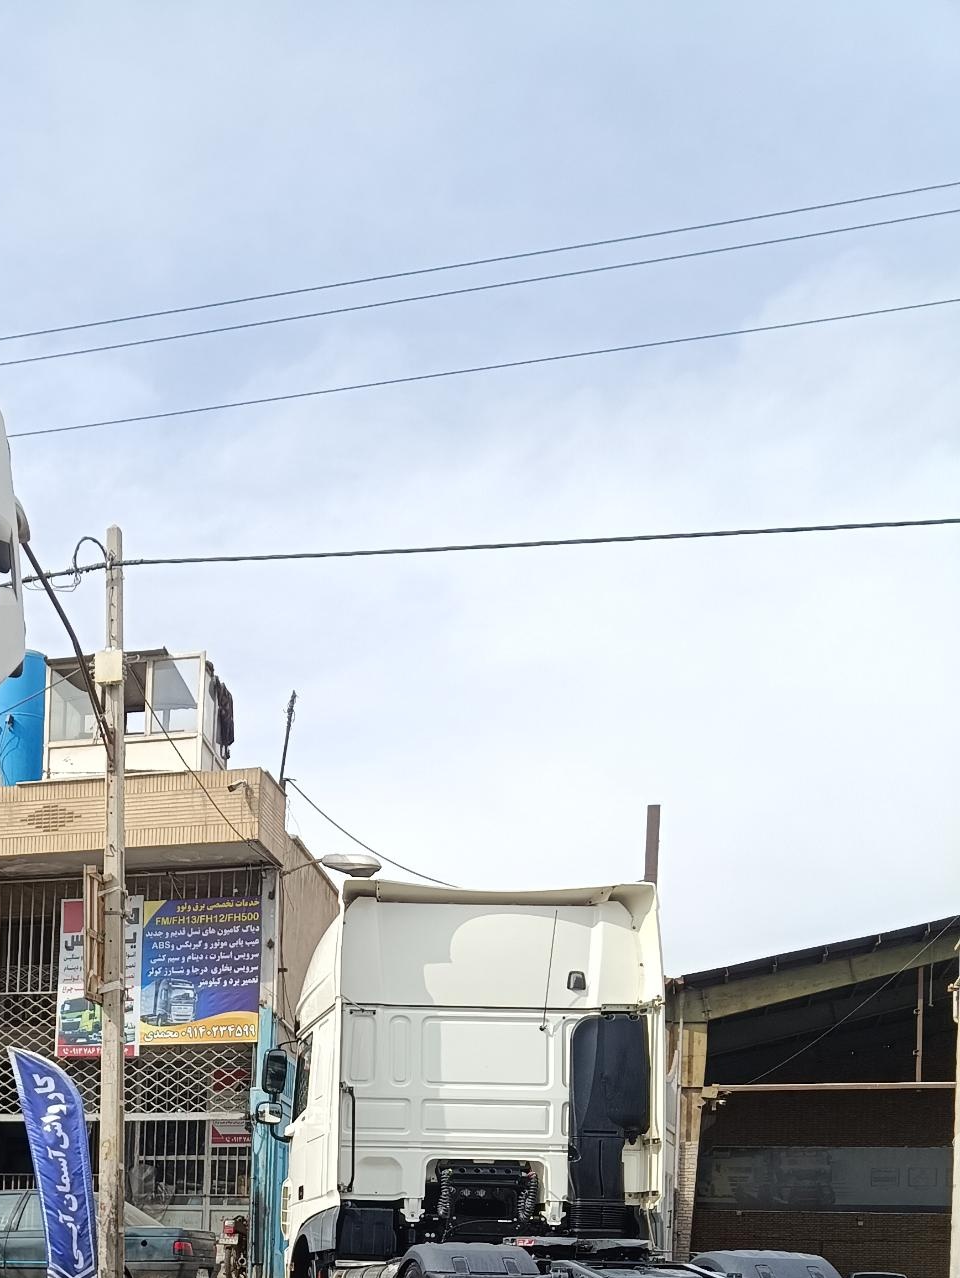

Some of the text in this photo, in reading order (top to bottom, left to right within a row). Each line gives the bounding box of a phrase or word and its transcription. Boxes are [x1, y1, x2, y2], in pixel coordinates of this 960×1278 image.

[206, 900, 233, 911] تخصصی
[235, 898, 260, 907] خدمات
[145, 929, 164, 938] جدید
[170, 927, 186, 938] قدیم
[217, 925, 240, 936] کامیون
[209, 939, 228, 949] موتور
[234, 951, 260, 960] سرویس
[211, 964, 232, 975] بخاری
[233, 965, 259, 973] سرویس
[143, 1029, 179, 1042] محمدی
[32, 1073, 85, 1271] کارواش آسمان آبی
